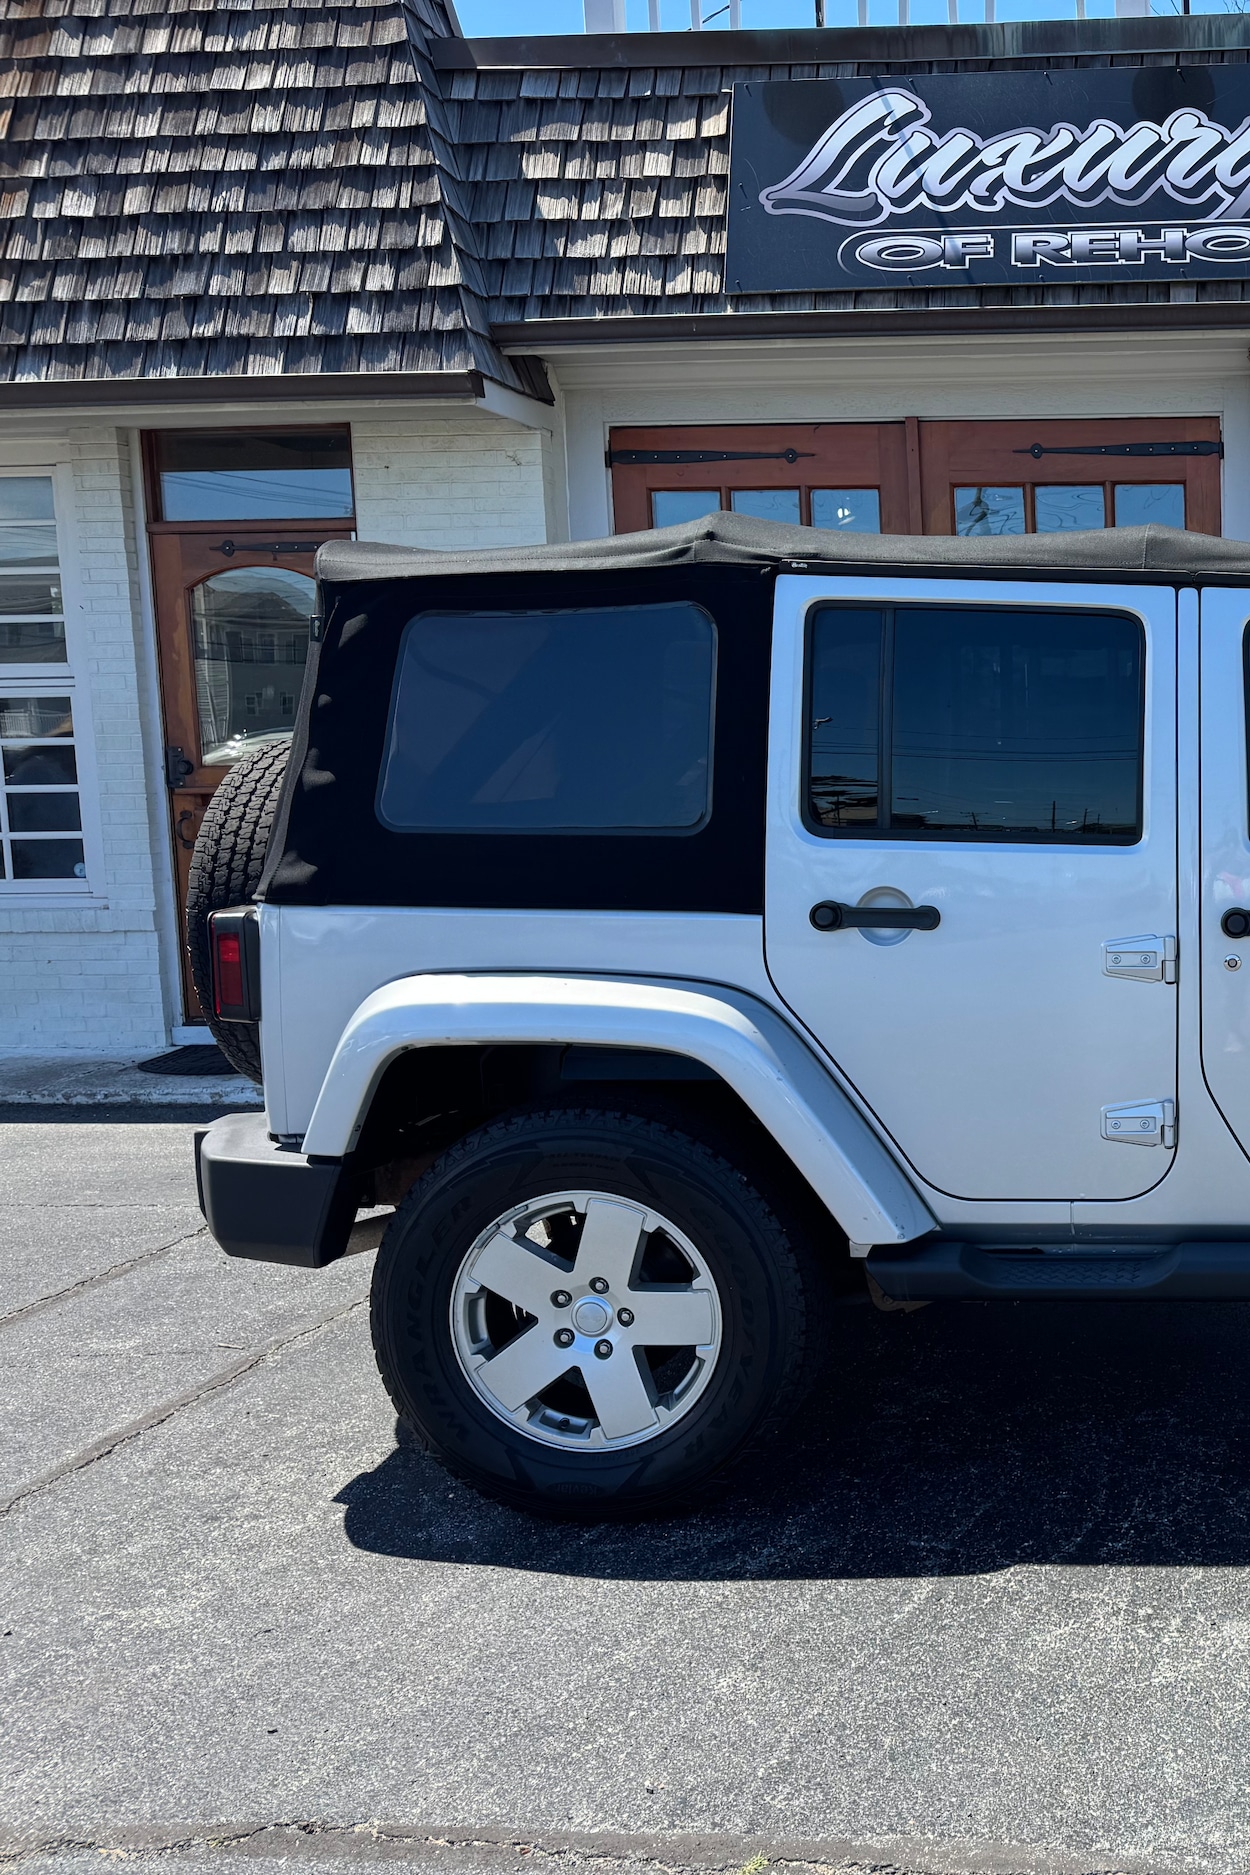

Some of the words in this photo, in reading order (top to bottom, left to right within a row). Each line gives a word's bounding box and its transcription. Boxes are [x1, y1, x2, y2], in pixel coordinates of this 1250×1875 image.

[855, 234, 994, 270] OF
[407, 1194, 473, 1442] WRANGLER
[682, 1206, 756, 1458] GOODYEAR
[555, 1483, 598, 1497] Kevlar
